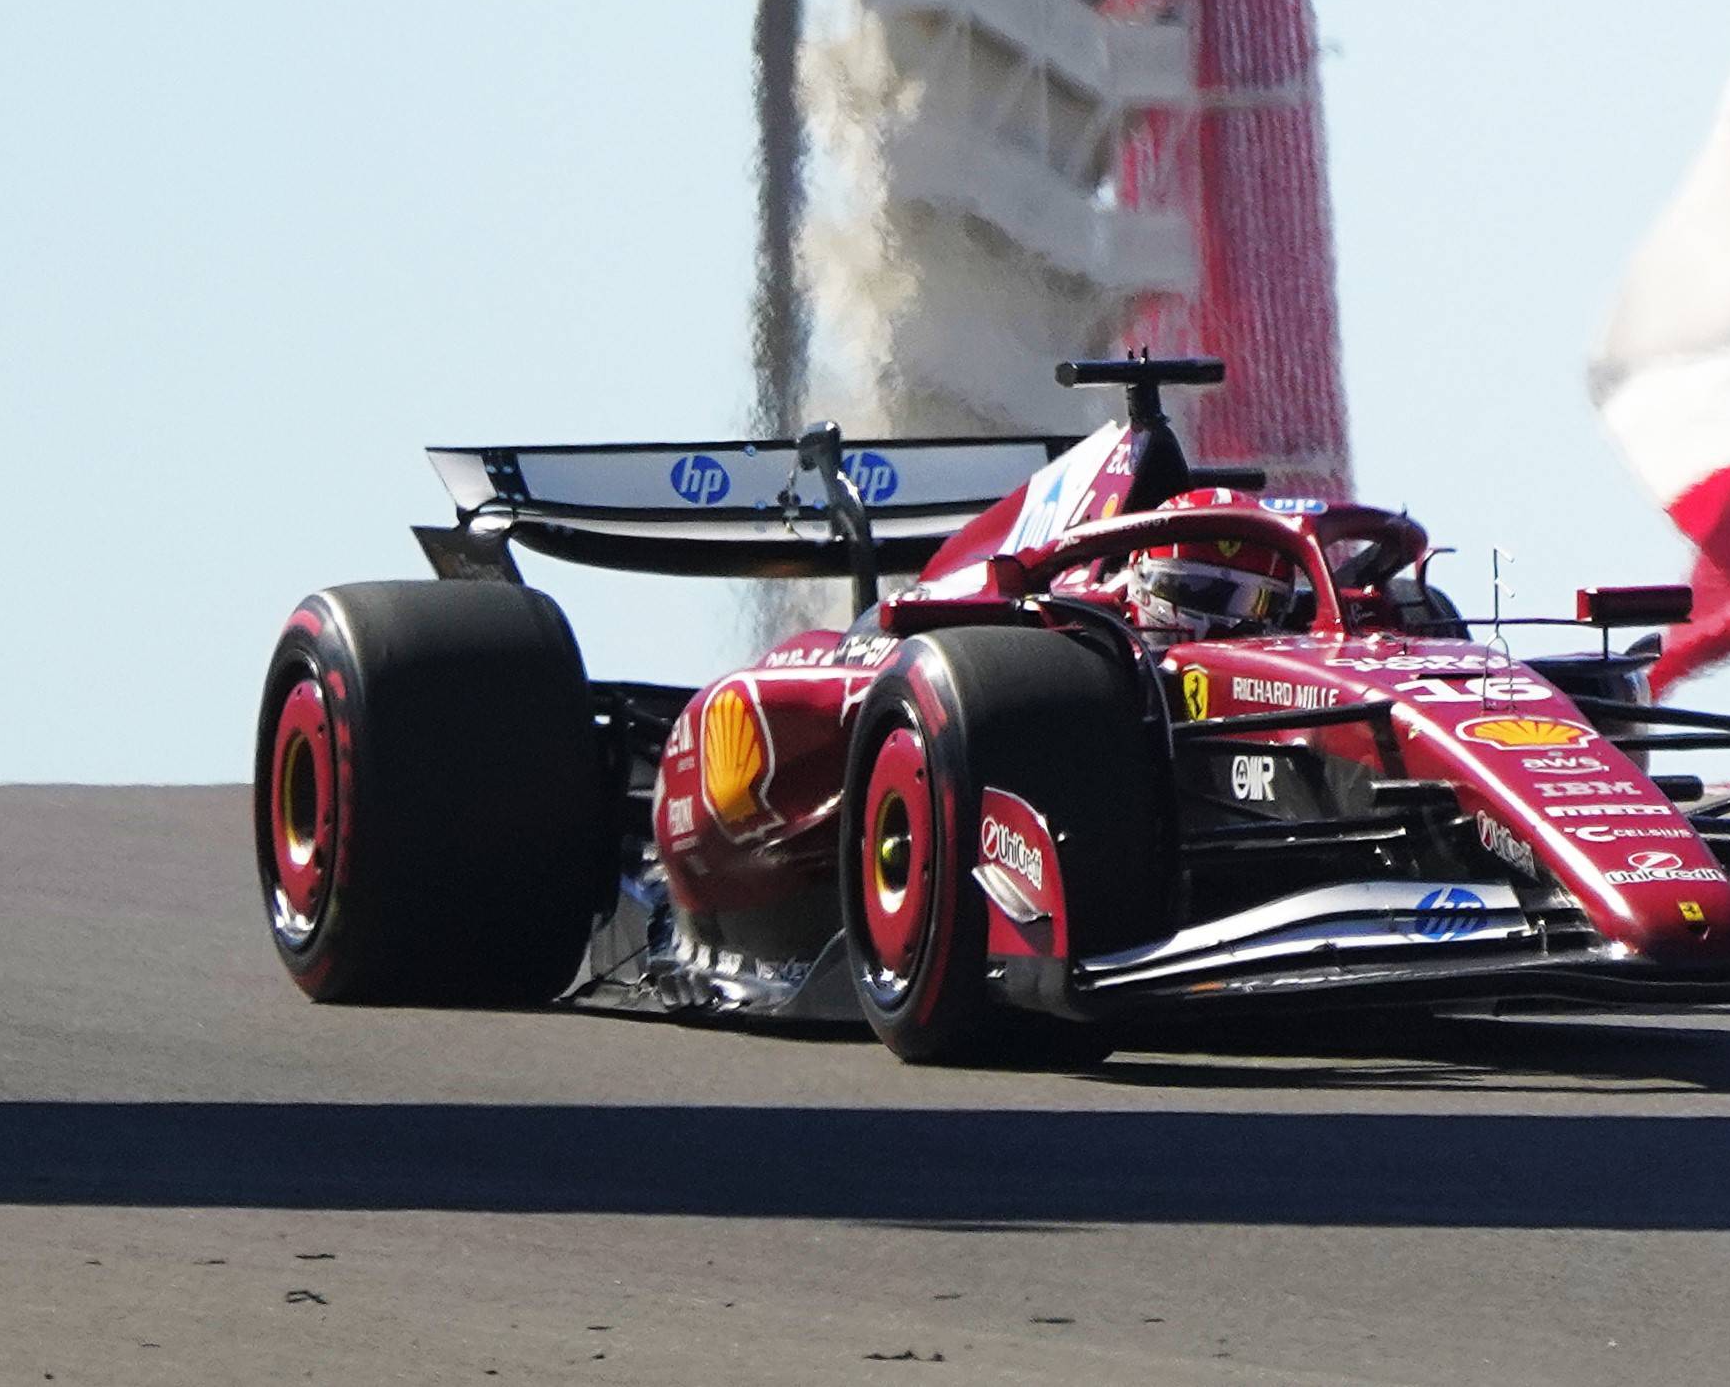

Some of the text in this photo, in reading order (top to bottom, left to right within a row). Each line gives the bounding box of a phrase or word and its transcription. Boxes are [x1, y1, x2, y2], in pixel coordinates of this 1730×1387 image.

[1233, 676, 1293, 706] RICHARD
[1393, 677, 1553, 702] 16
[1522, 756, 1603, 769] aws
[1533, 781, 1643, 798] IBM
[1613, 827, 1694, 839] CELSIUS
[1607, 868, 1727, 884] UniCredit
